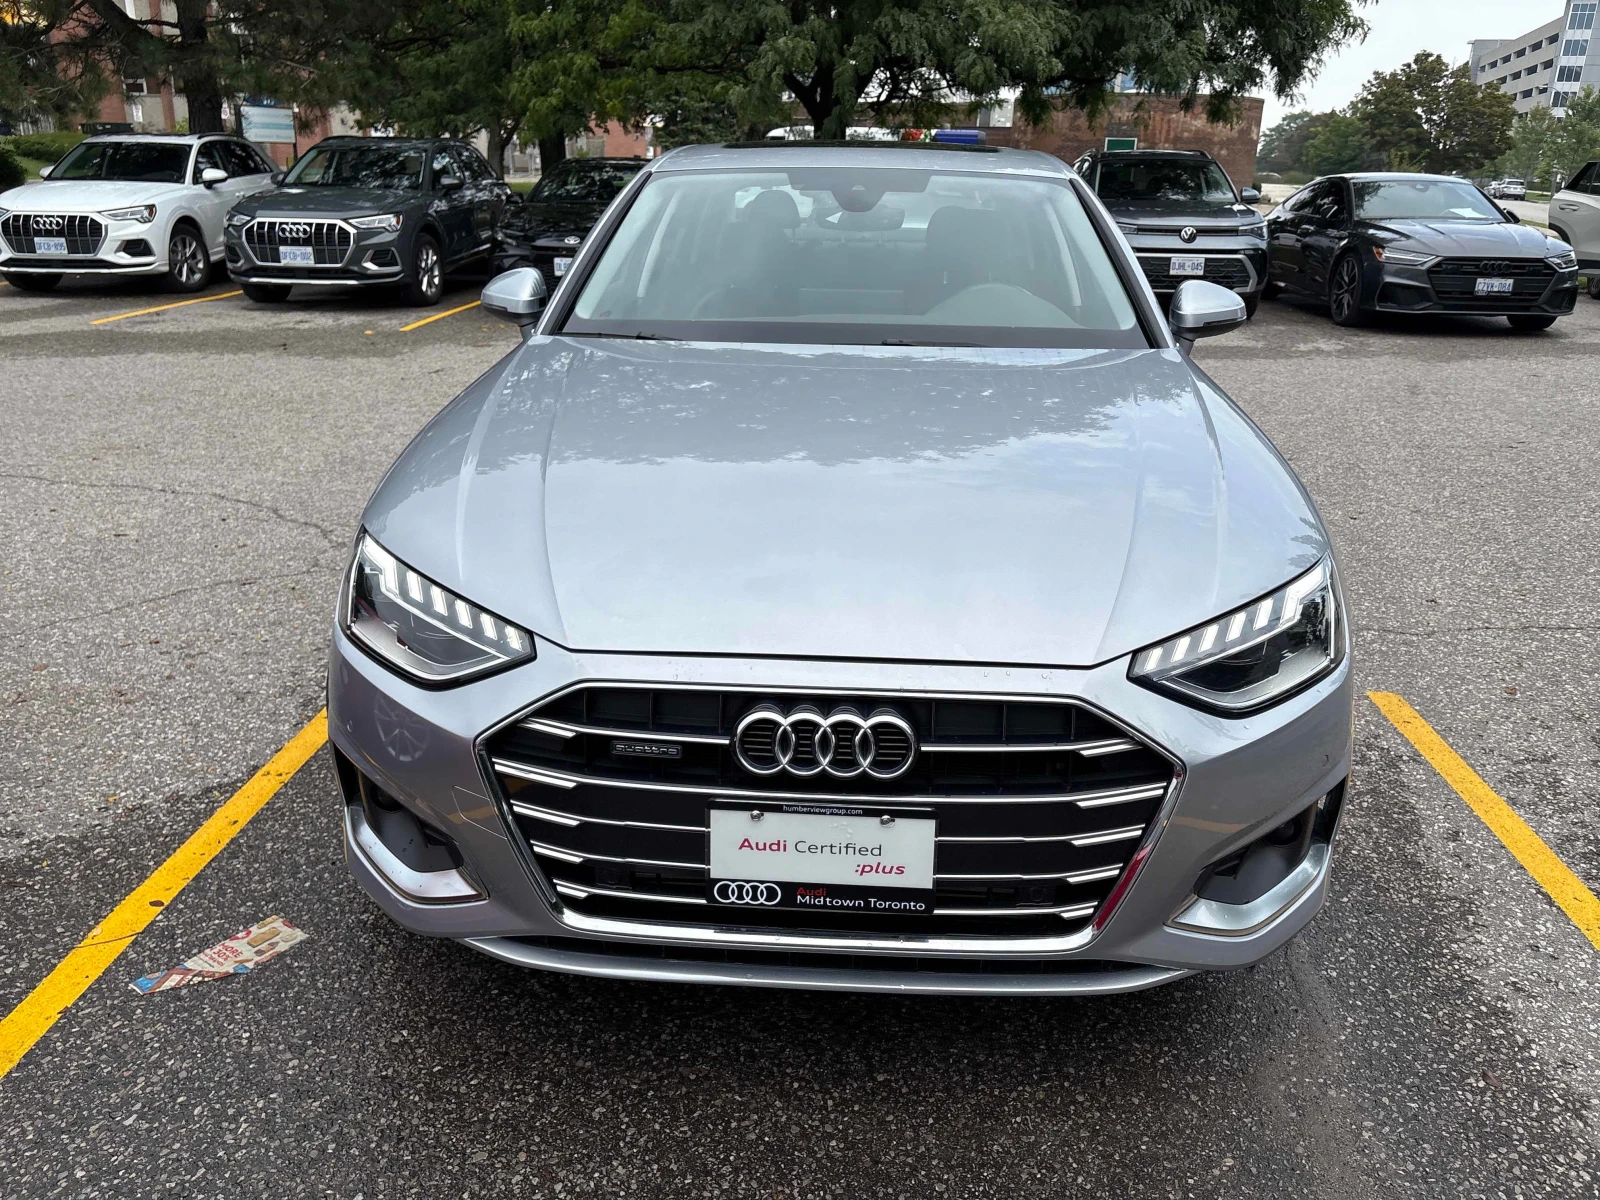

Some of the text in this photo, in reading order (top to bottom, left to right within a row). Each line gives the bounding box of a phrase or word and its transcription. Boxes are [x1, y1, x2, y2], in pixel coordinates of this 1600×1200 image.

[615, 744, 678, 755] quattro
[783, 804, 863, 815] humberviewgroup.com
[738, 837, 882, 857] Audi Certified
[854, 861, 906, 876] :plus
[796, 886, 827, 896] Audi
[796, 895, 925, 911] Midtown Toronto
